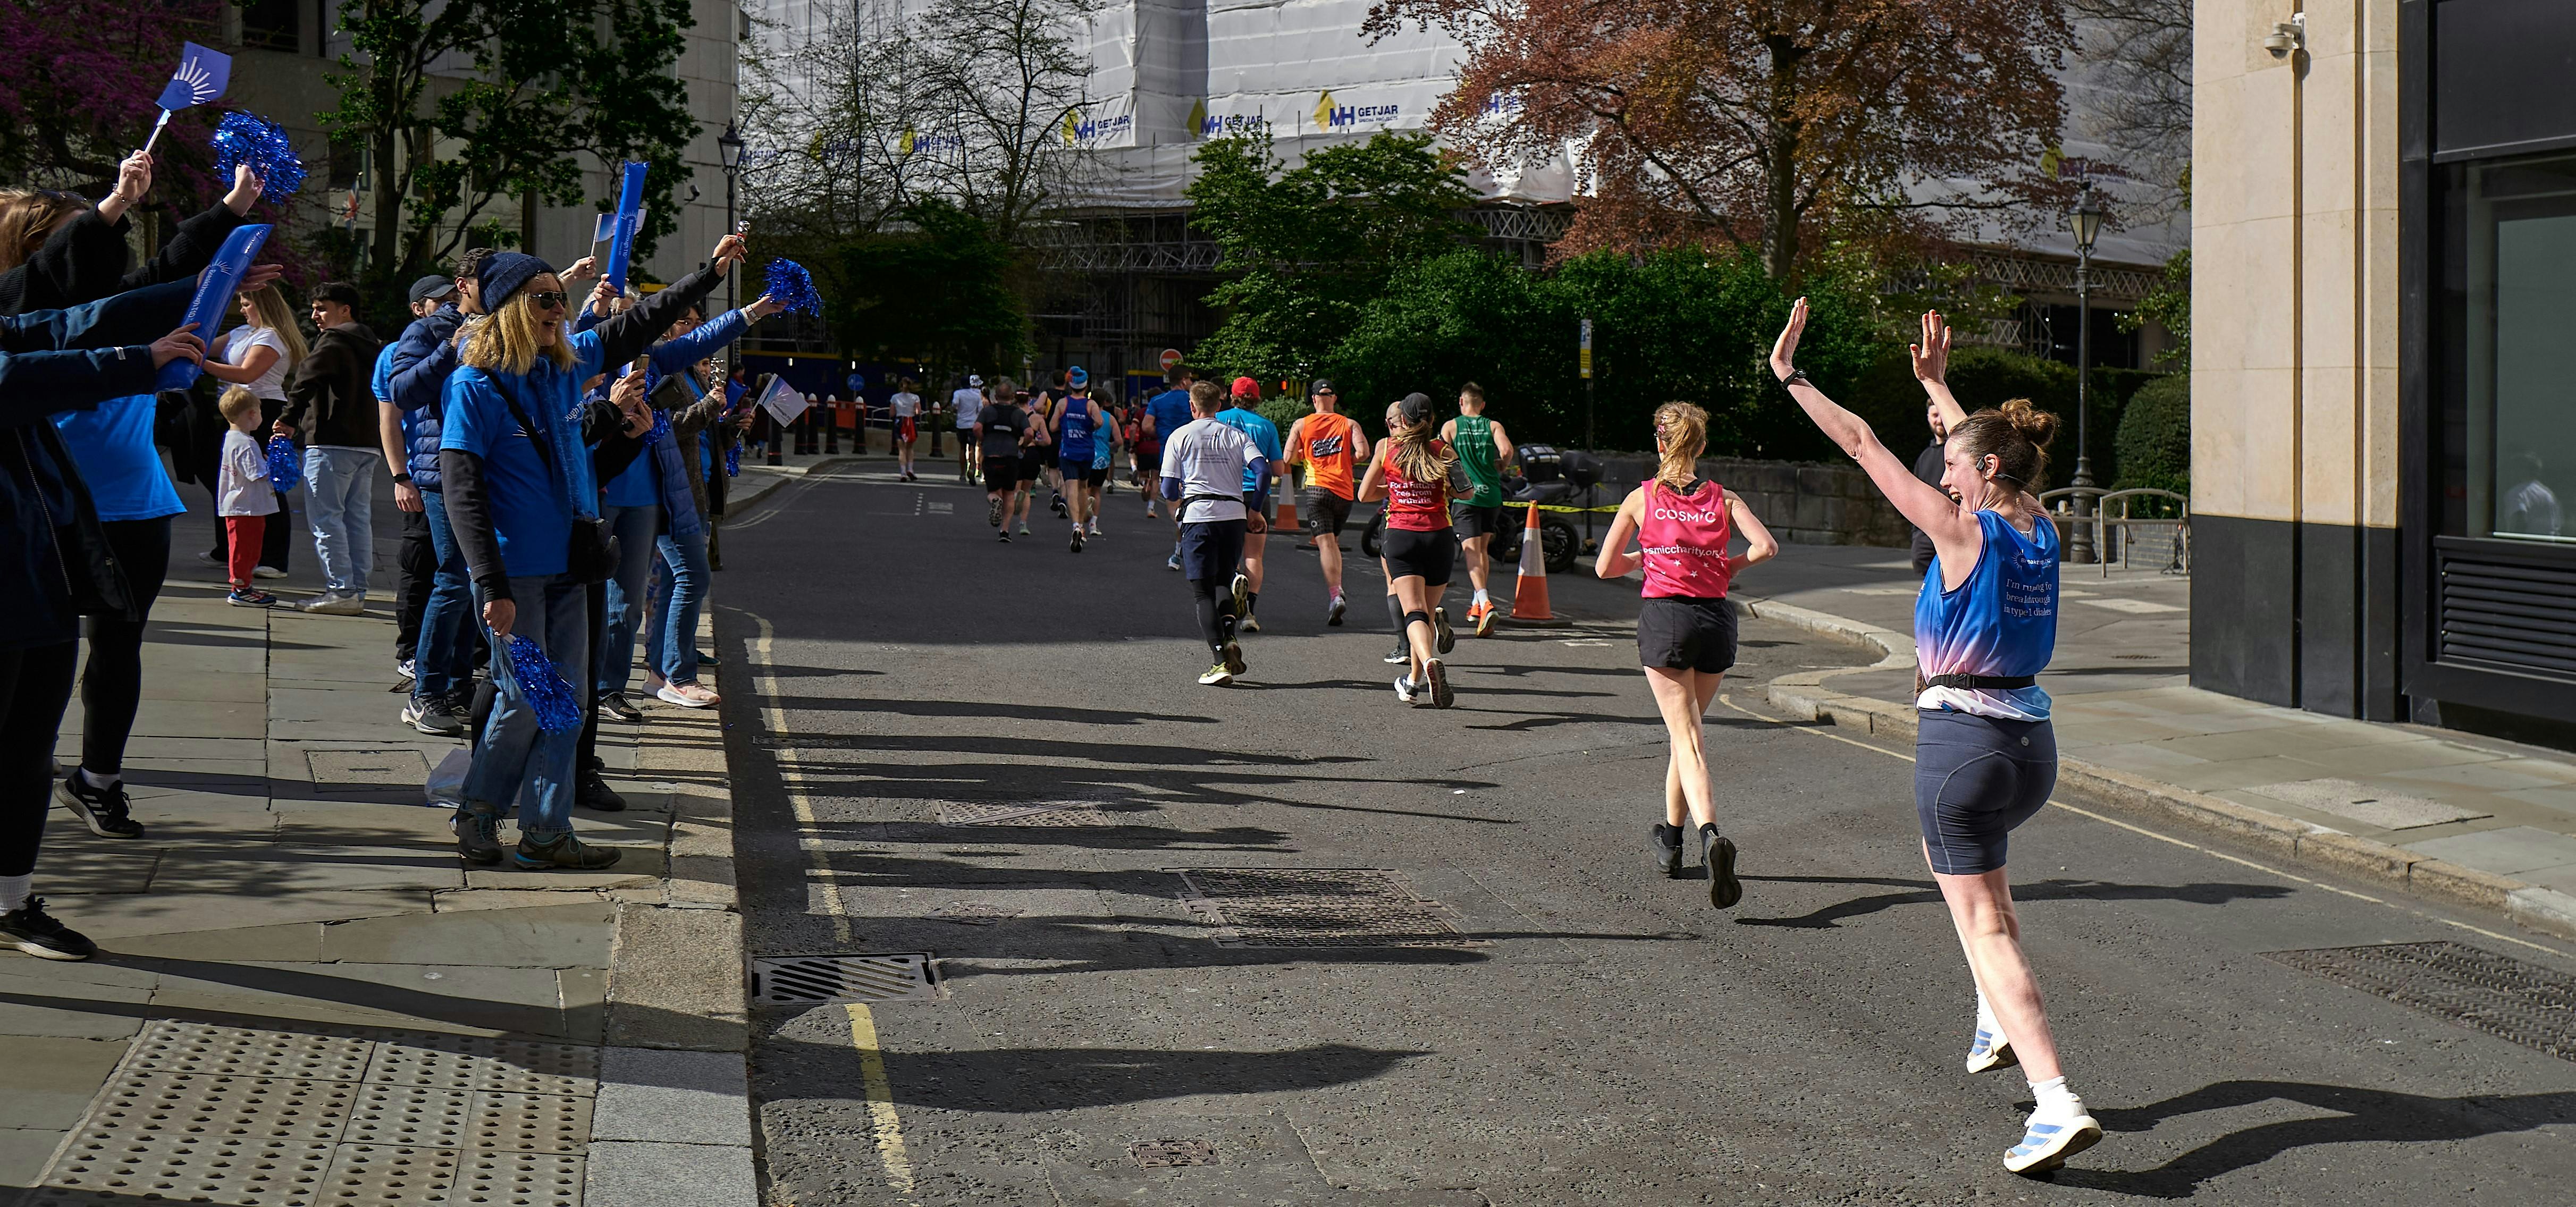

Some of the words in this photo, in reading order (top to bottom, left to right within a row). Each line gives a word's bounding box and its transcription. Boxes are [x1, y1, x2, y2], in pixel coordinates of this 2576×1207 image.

[1098, 115, 1130, 129] GETJAR
[1329, 106, 1355, 127] MH
[1358, 105, 1398, 116] GETJAR
[1200, 115, 1223, 133] MH
[2006, 578, 2020, 589] I'm
[2011, 607, 2028, 617] type
